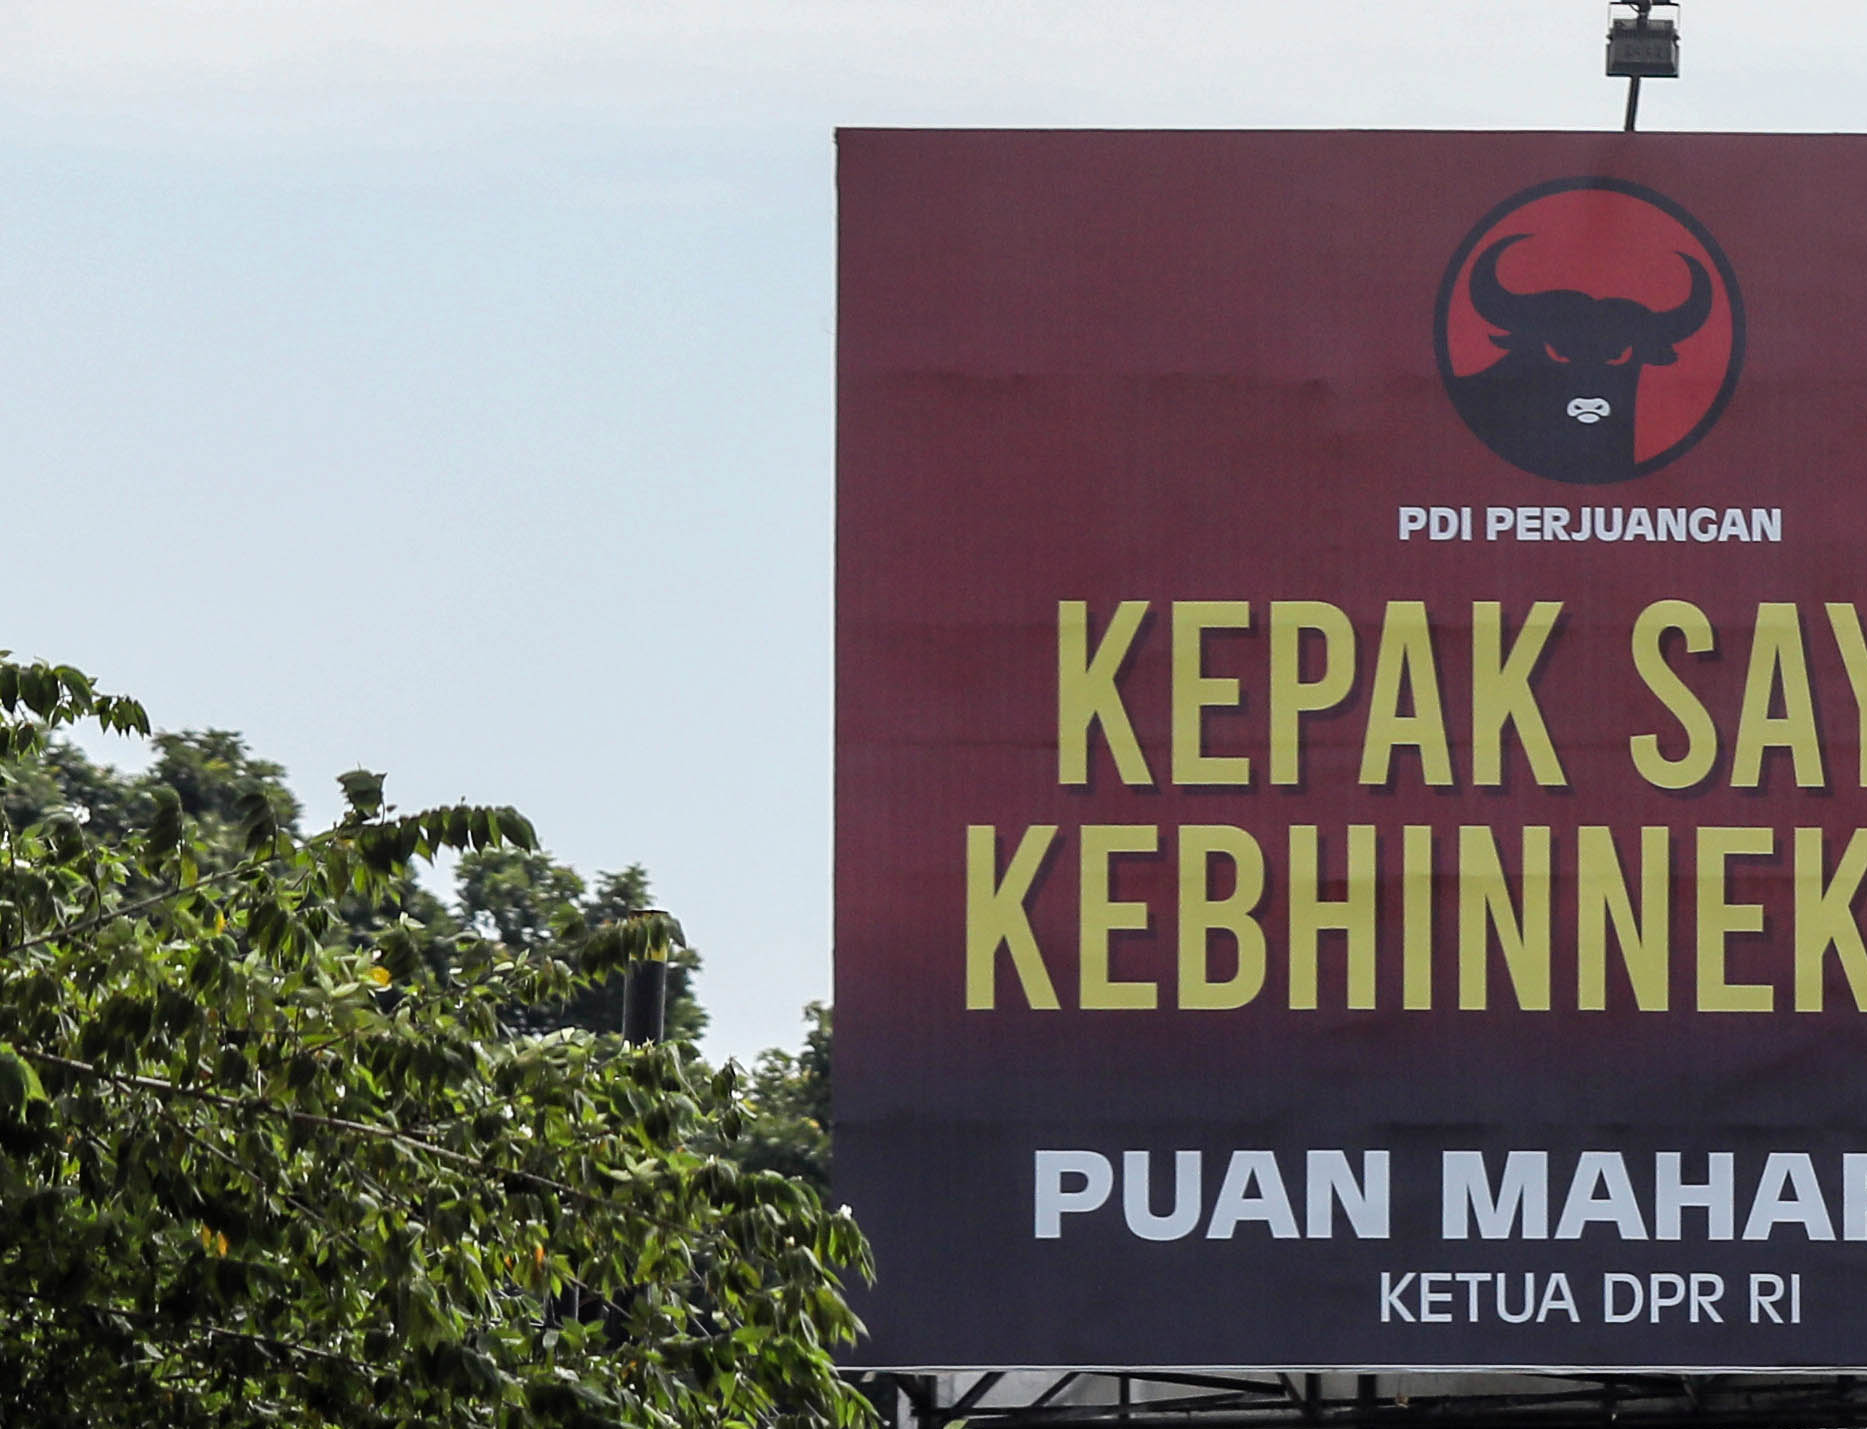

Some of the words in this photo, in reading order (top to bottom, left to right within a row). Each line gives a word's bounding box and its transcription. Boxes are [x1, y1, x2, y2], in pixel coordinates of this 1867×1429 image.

[1399, 508, 1473, 541] PDI
[1486, 508, 1782, 542] PERJUANGAN
[1057, 600, 1568, 787] KEPAK
[1033, 1149, 1390, 1240] PUAN
[1380, 1273, 1580, 1324] KETUA
[1603, 1274, 1726, 1324] DPR
[1749, 1274, 1801, 1324] RI
